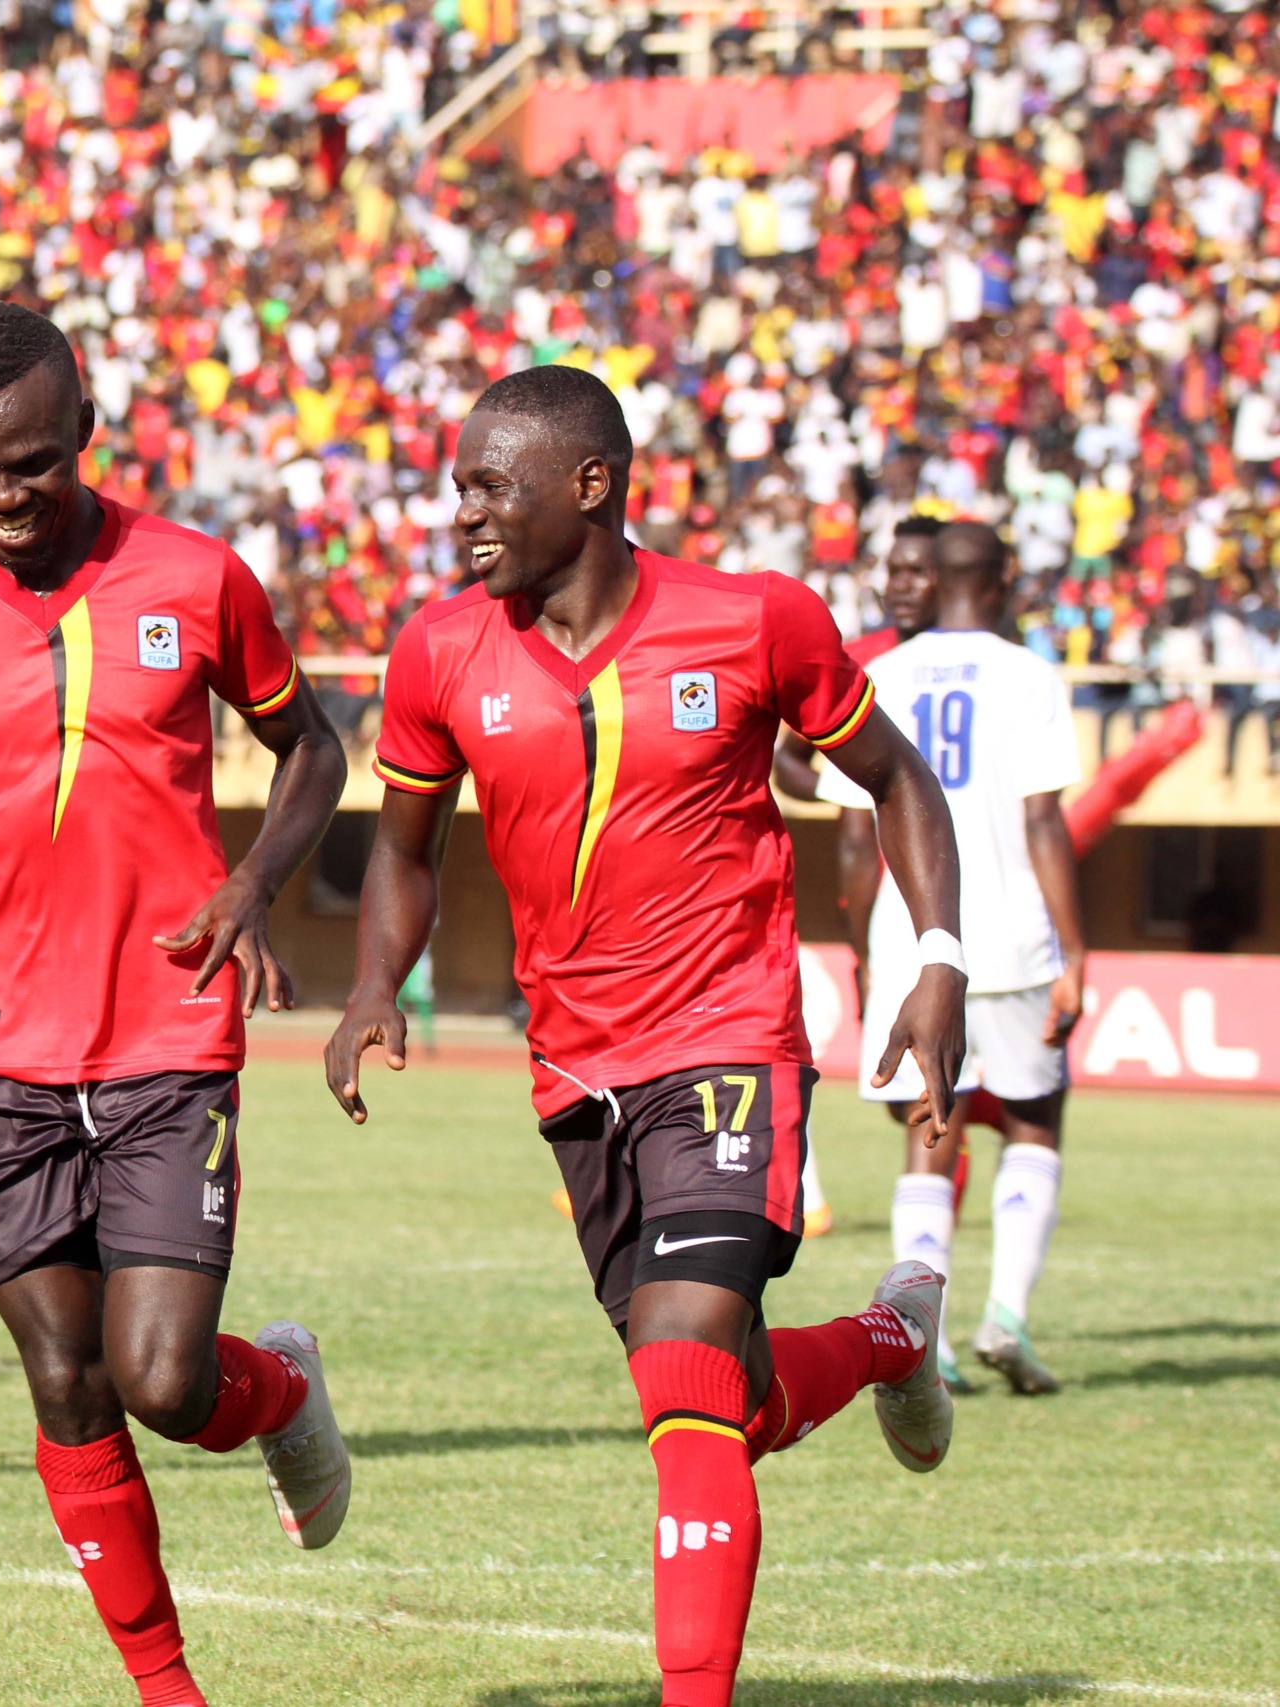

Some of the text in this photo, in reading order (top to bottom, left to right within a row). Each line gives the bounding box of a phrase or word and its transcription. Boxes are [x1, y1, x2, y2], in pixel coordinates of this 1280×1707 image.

[147, 655, 173, 666] FUFA
[681, 716, 709, 726] FUFA
[911, 690, 975, 789] 19
[180, 996, 222, 1005] Cool Breeze
[1082, 985, 1261, 1080] AL
[693, 1075, 757, 1133] 17
[205, 1109, 227, 1170] 7
